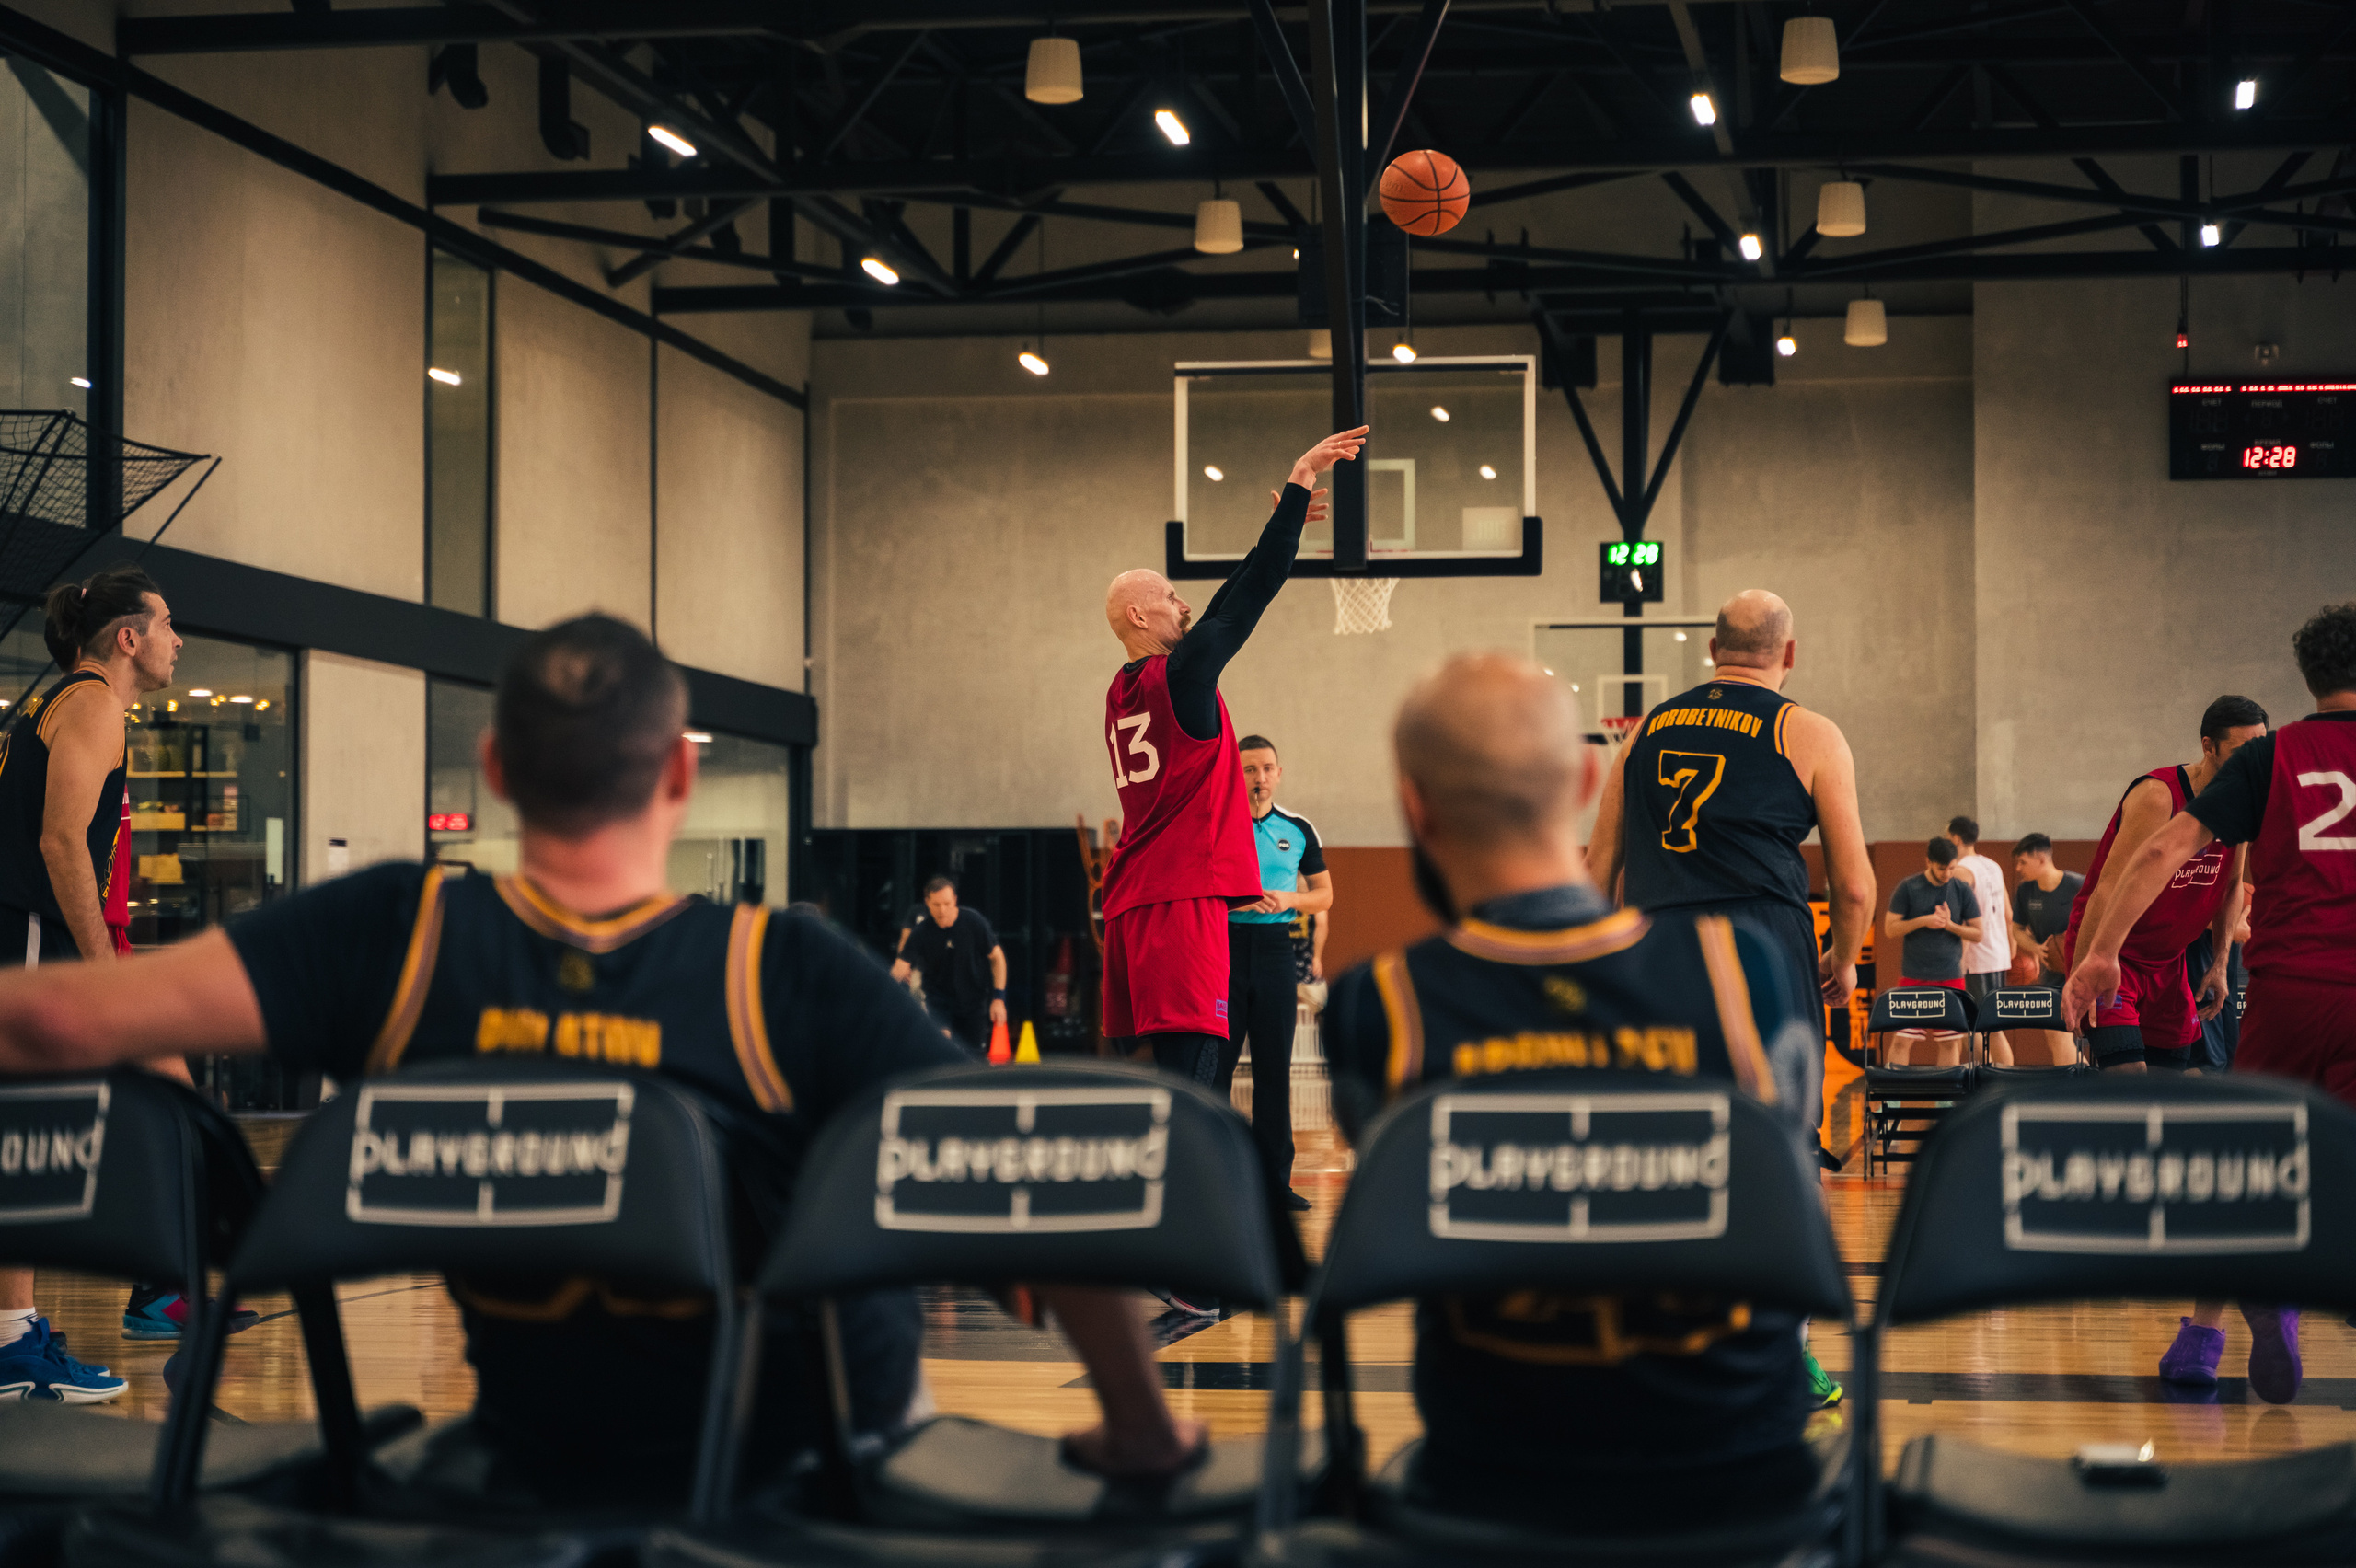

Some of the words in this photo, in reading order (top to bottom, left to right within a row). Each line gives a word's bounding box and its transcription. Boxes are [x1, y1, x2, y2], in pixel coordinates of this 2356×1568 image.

[2243, 446, 2297, 468] 12:28
[1646, 708, 1764, 739] KOROBEYNIKOV
[1109, 711, 1160, 789] 13
[1658, 749, 1727, 854] 7
[2296, 771, 2356, 851] 2
[2175, 862, 2221, 881] PLAOUND
[1889, 997, 1945, 1010] PLAYGROUND
[1997, 997, 2052, 1010] PLAYGROUND
